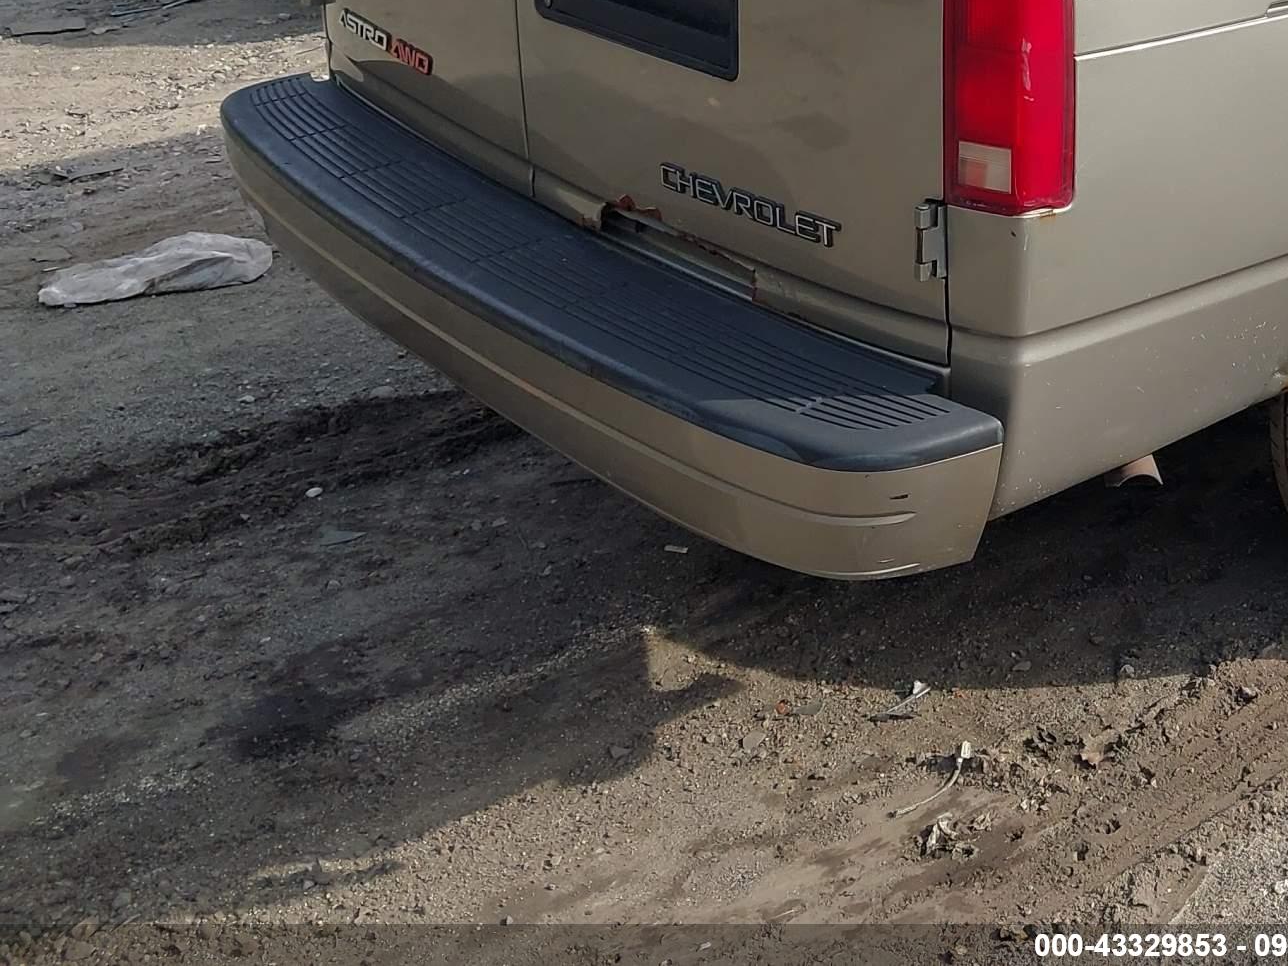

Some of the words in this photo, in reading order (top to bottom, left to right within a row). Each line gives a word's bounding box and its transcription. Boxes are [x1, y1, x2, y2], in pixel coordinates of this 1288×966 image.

[339, 9, 389, 51] ASTRO
[391, 39, 432, 75] AWD
[660, 163, 840, 247] CHEVROLET
